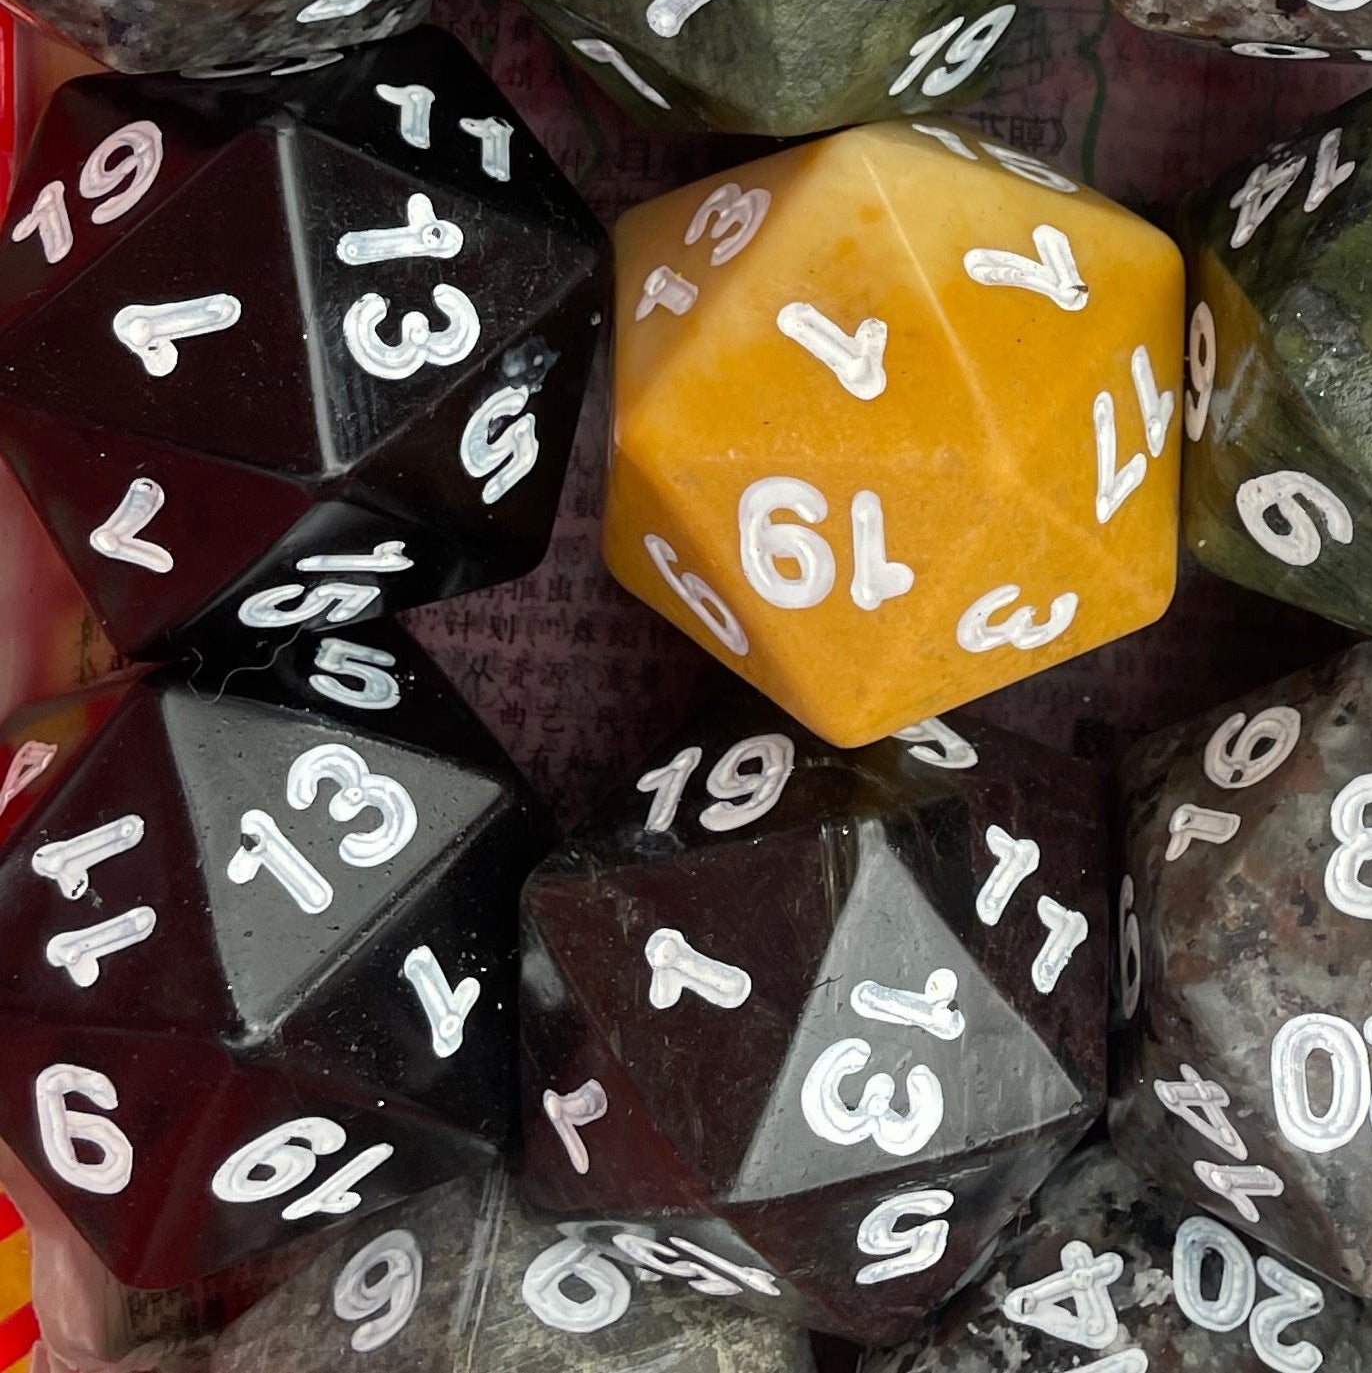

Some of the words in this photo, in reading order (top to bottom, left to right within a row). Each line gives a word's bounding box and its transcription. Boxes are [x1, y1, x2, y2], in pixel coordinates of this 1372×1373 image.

[888, 4, 1016, 97] 19
[12, 121, 163, 264] 19
[1230, 127, 1356, 249] 14
[336, 192, 480, 380] 13
[635, 181, 771, 321] 13
[113, 293, 241, 377] 1
[460, 385, 539, 504] 5
[1092, 344, 1175, 524] 17
[237, 540, 414, 628] 15
[955, 583, 1079, 654] 3
[308, 637, 400, 709] 5
[226, 742, 418, 915] 13
[636, 732, 796, 832] 19
[31, 813, 157, 988] 11
[644, 928, 753, 1010] 1
[801, 968, 964, 1156] 13
[1153, 1063, 1284, 1222] 14
[856, 1190, 954, 1285] 5
[1173, 1216, 1323, 1373] 20
